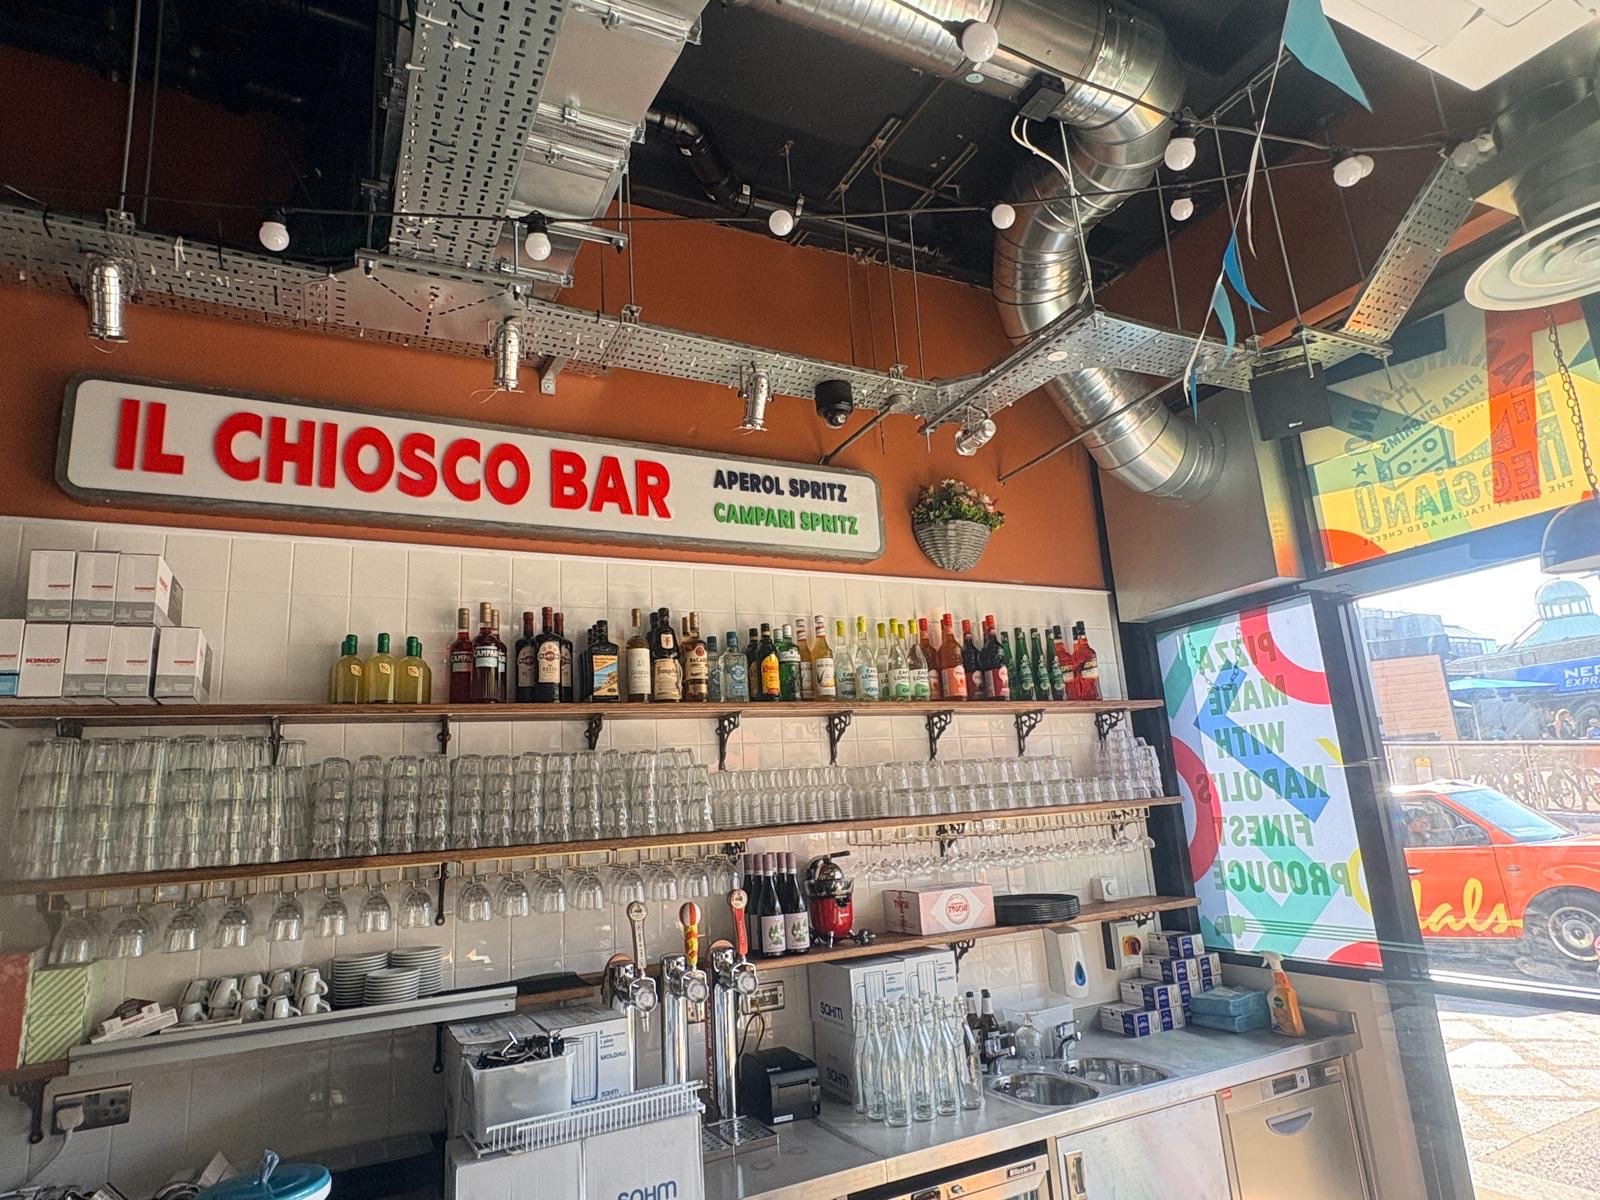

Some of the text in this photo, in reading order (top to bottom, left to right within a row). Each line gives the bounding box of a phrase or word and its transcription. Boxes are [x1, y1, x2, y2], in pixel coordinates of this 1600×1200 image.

[114, 397, 672, 520] IL CHIOSCO BAR
[713, 469, 848, 502] APEROL SPRITZ
[713, 502, 859, 536] CAMPARI SPRITZ
[600, 1051, 627, 1061] MOLDAU
